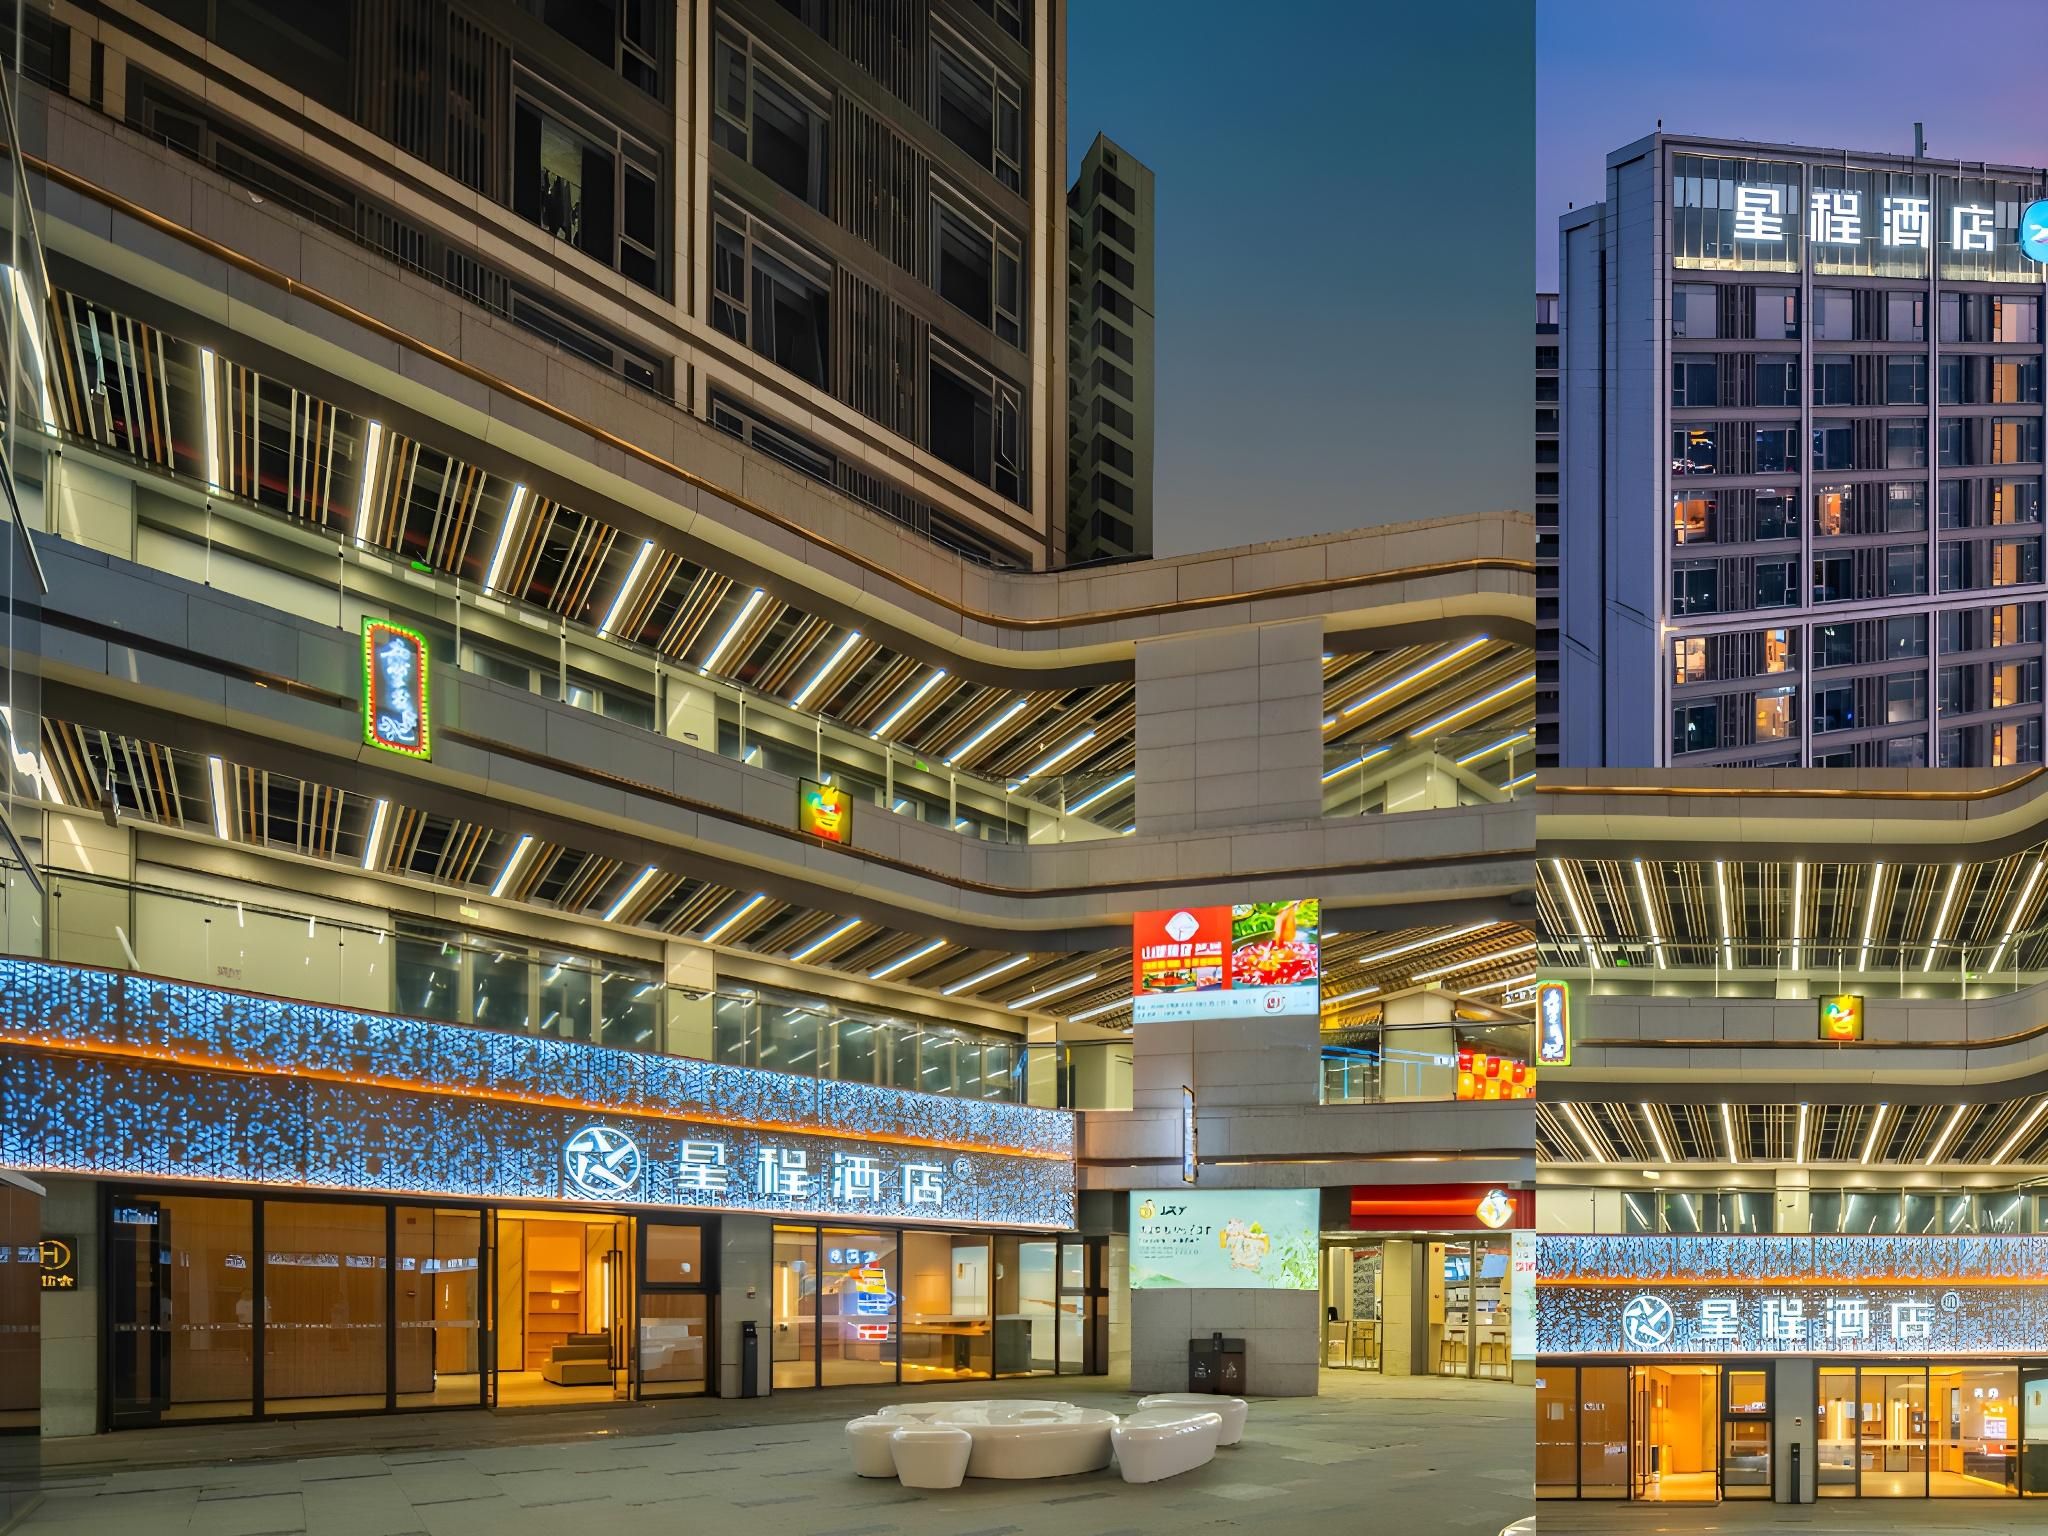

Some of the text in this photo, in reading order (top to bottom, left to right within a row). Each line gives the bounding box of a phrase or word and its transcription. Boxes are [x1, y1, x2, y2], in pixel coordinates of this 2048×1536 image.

[1734, 186, 1994, 251] 星程酒店
[677, 1139, 944, 1204] 星程酒店
[1701, 1297, 1934, 1340] 星程酒店
